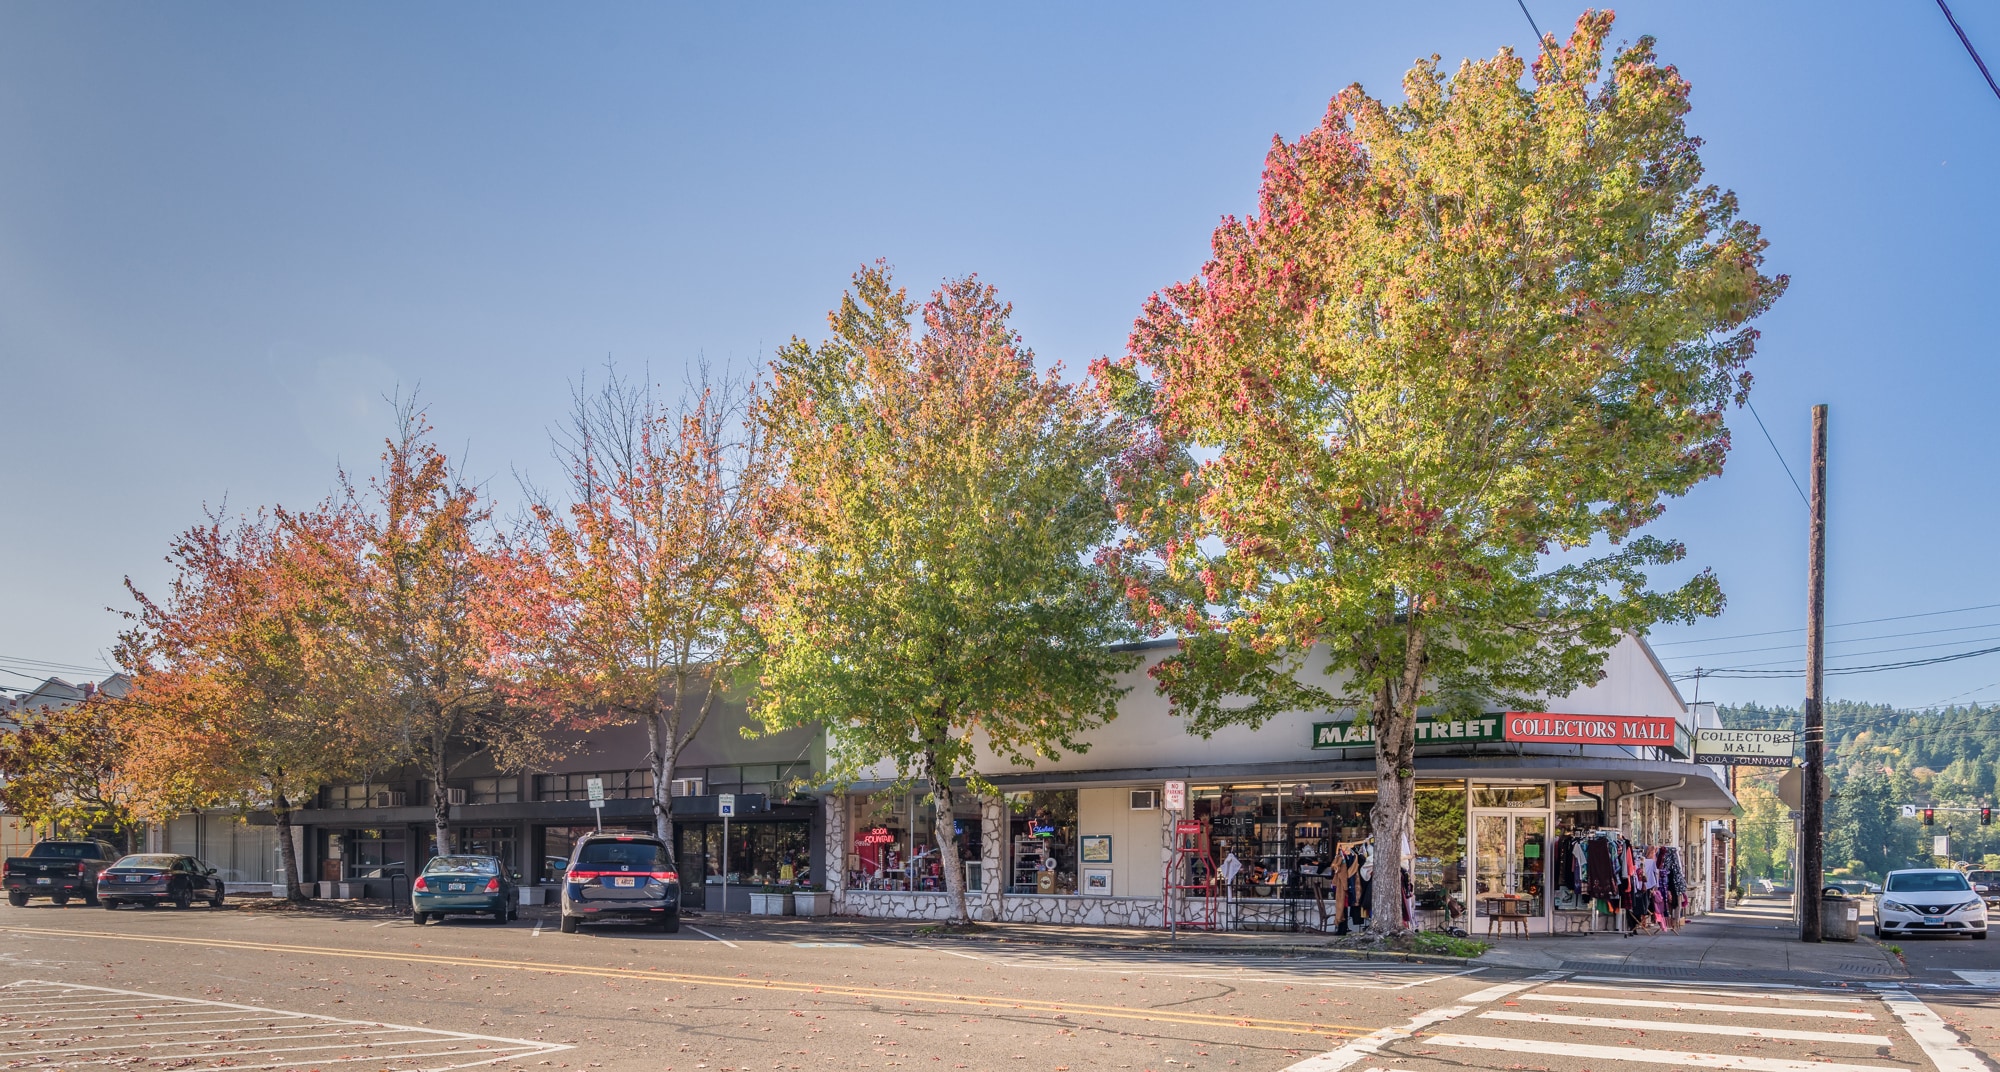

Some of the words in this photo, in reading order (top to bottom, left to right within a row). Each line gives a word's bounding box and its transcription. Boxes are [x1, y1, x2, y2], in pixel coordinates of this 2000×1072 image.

[1318, 726, 1375, 744] MAI
[1415, 719, 1497, 739] TREET
[1511, 718, 1616, 738] COLLECTORS
[1622, 722, 1670, 740] MALL
[1701, 731, 1790, 744] COLLECTORS
[1723, 743, 1764, 753] MALL
[1699, 755, 1727, 764] SODA
[864, 835, 894, 843] FOUNTAIN
